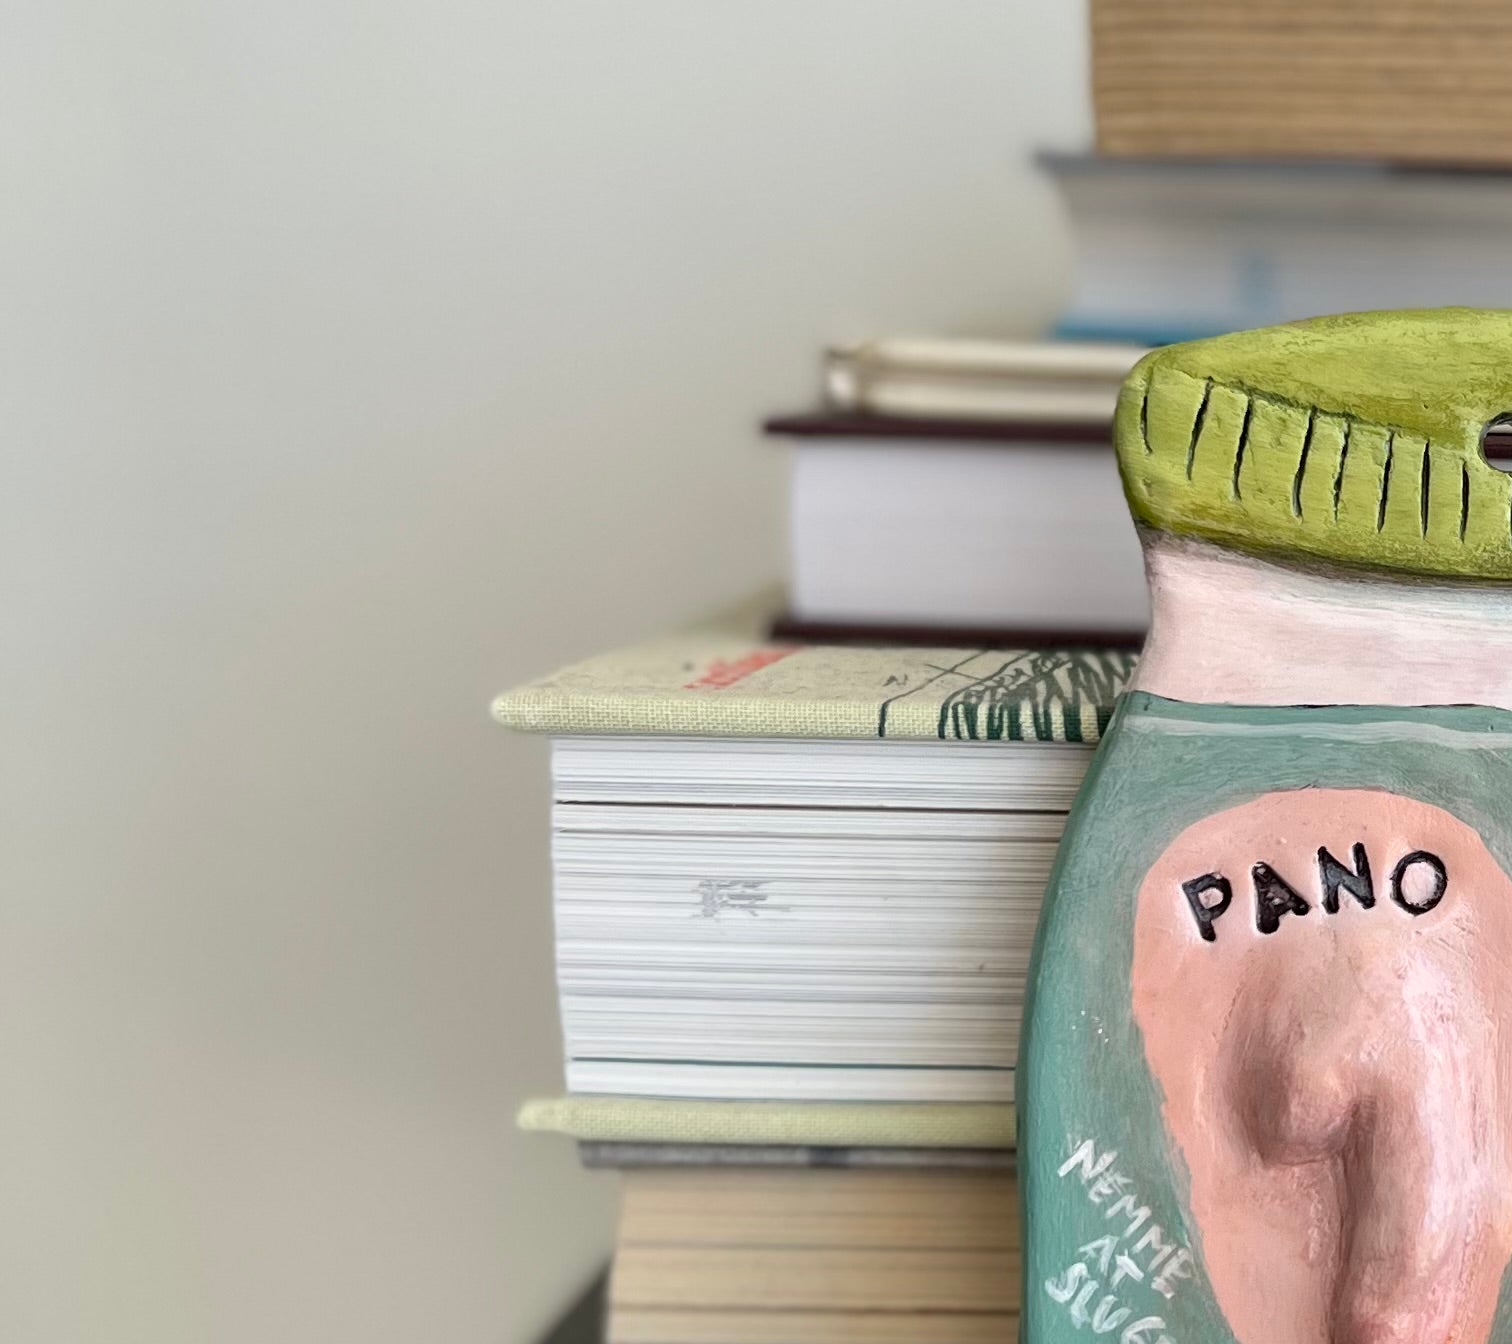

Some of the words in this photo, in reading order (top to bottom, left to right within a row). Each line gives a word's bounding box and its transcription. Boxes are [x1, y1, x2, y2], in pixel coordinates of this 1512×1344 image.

[1181, 842, 1448, 942] PANO
[1058, 1139, 1193, 1299] NEMME
[1078, 1234, 1144, 1289] AT
